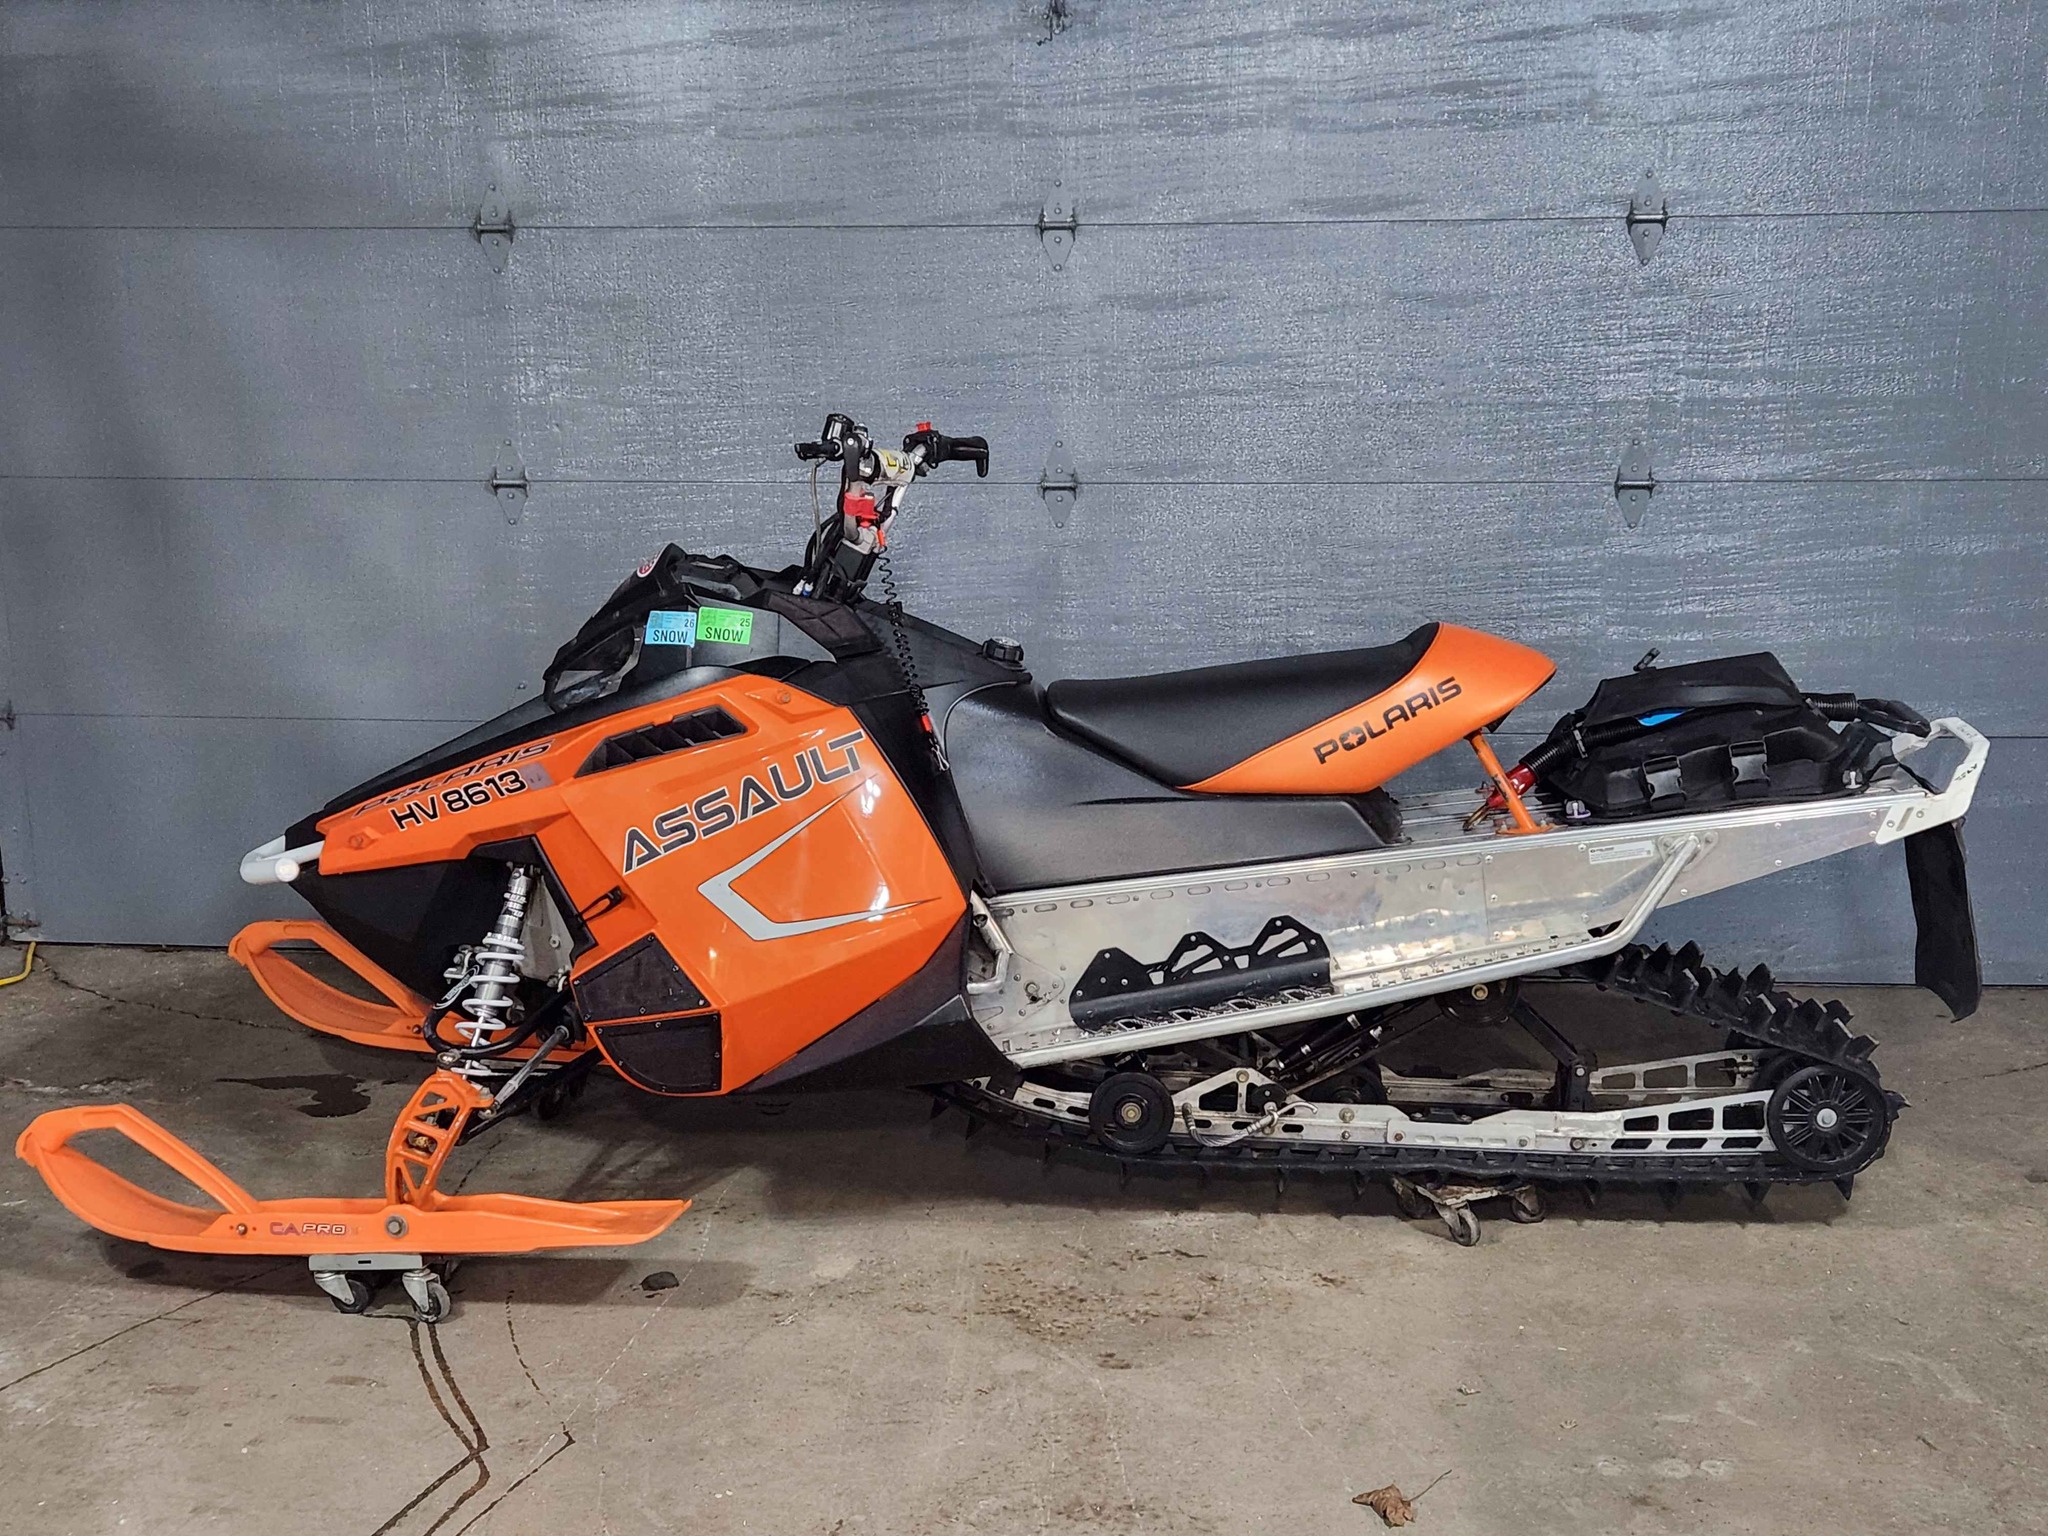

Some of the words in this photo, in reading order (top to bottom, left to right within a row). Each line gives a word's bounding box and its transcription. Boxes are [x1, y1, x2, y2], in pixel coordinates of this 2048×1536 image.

[684, 619, 695, 628] 26
[739, 618, 751, 627] 25
[652, 629, 688, 643] SNOW
[704, 627, 744, 642] SNOW
[1313, 676, 1462, 765] POLARIS
[389, 794, 439, 831] HV
[443, 769, 527, 813] 8613
[623, 729, 865, 875] ASSAULT
[302, 1222, 346, 1236] PRO
